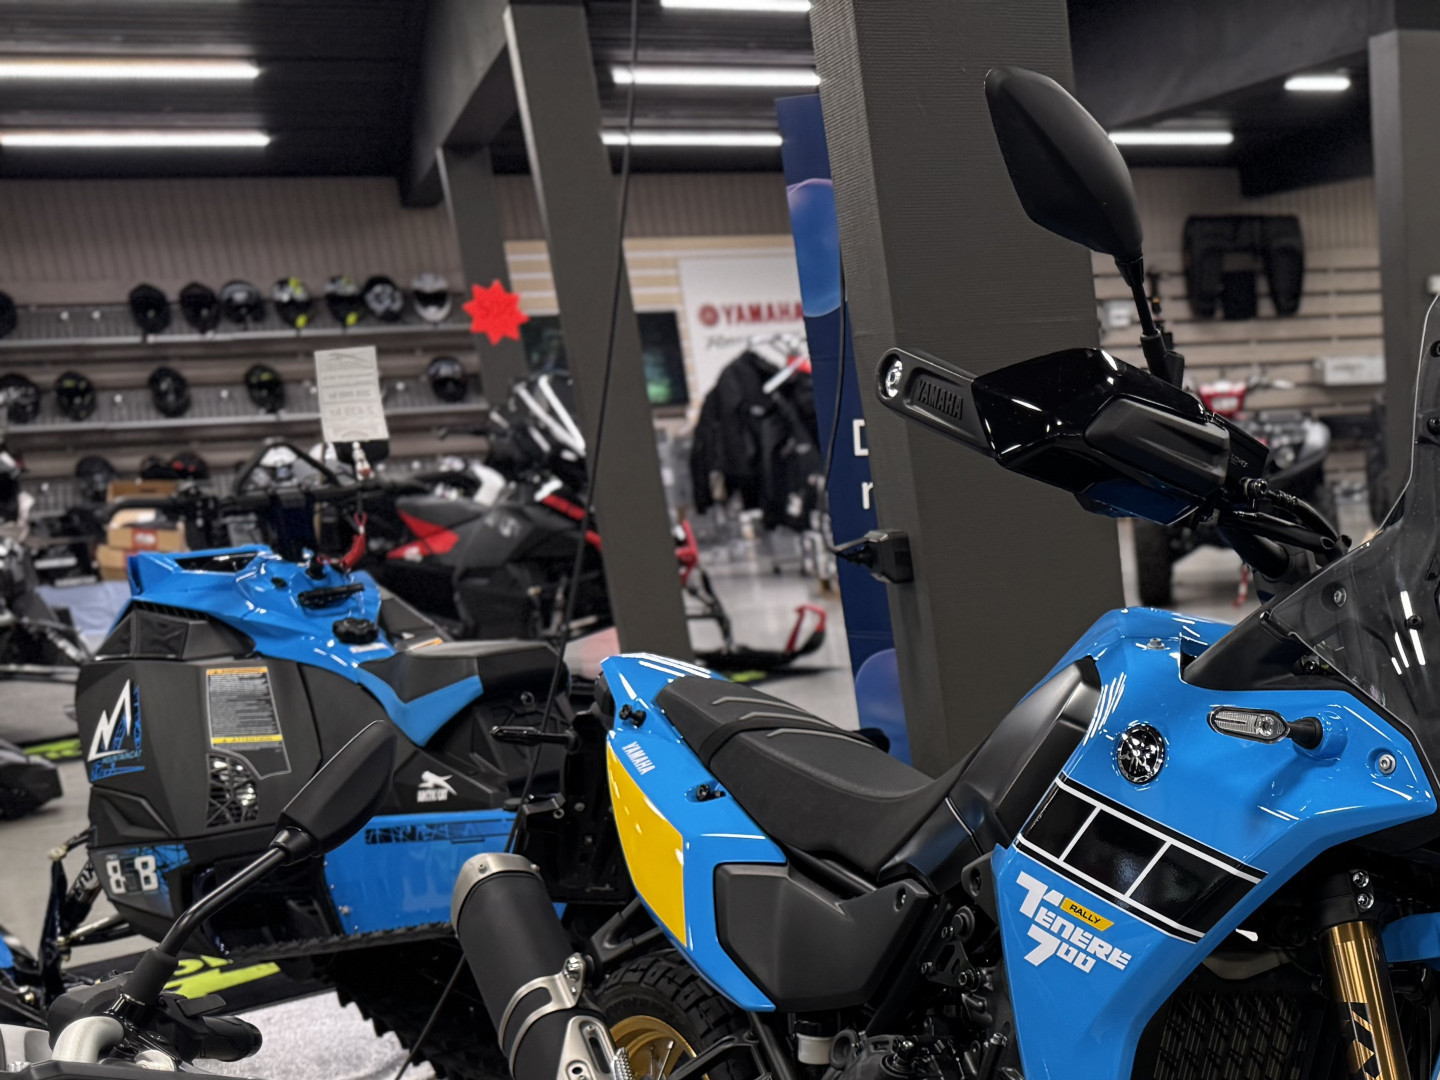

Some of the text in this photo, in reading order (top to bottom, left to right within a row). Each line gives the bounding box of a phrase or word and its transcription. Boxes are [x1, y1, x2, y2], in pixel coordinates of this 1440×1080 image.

[918, 379, 964, 421] YAMAHA
[621, 740, 656, 776] YAMAHA
[1069, 903, 1102, 925] RALLY
[1023, 923, 1097, 974] 700
